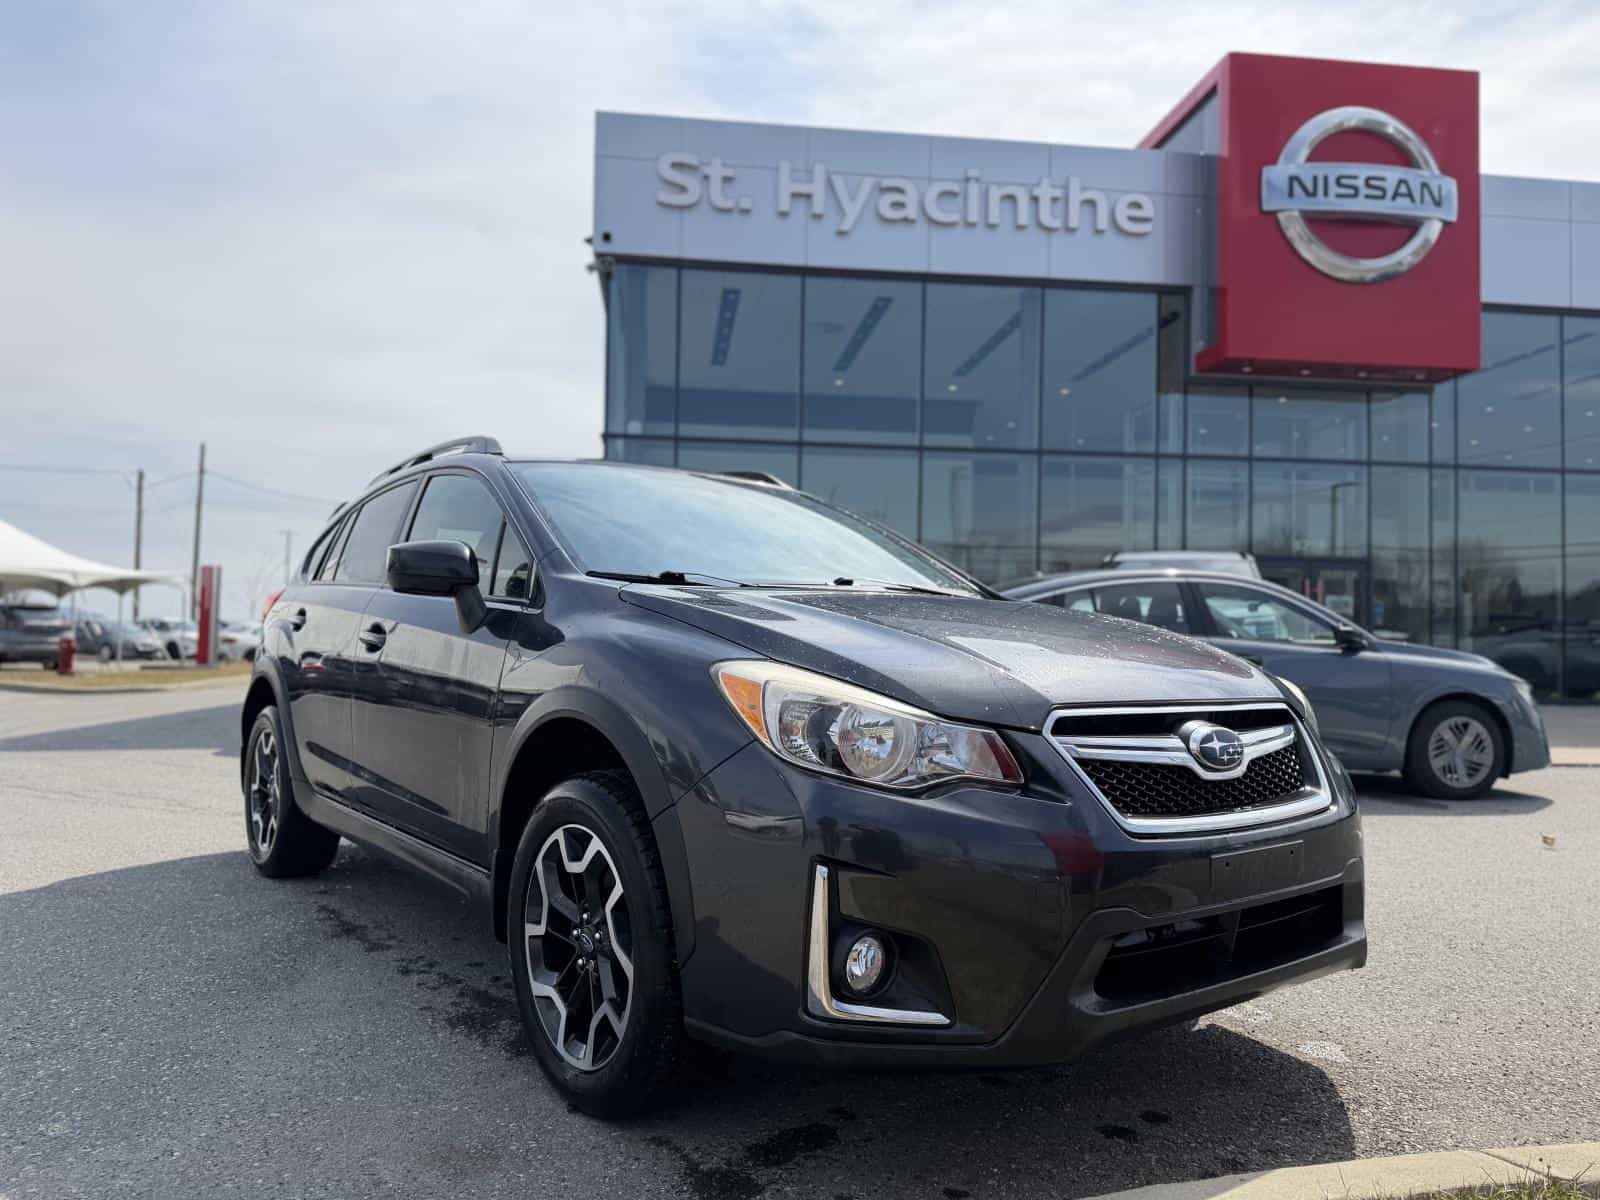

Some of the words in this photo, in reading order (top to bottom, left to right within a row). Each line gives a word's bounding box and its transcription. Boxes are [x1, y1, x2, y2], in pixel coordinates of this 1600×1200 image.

[656, 152, 752, 213] St.
[777, 161, 1155, 237] Hyacinthe
[1287, 174, 1443, 207] NISSAN
